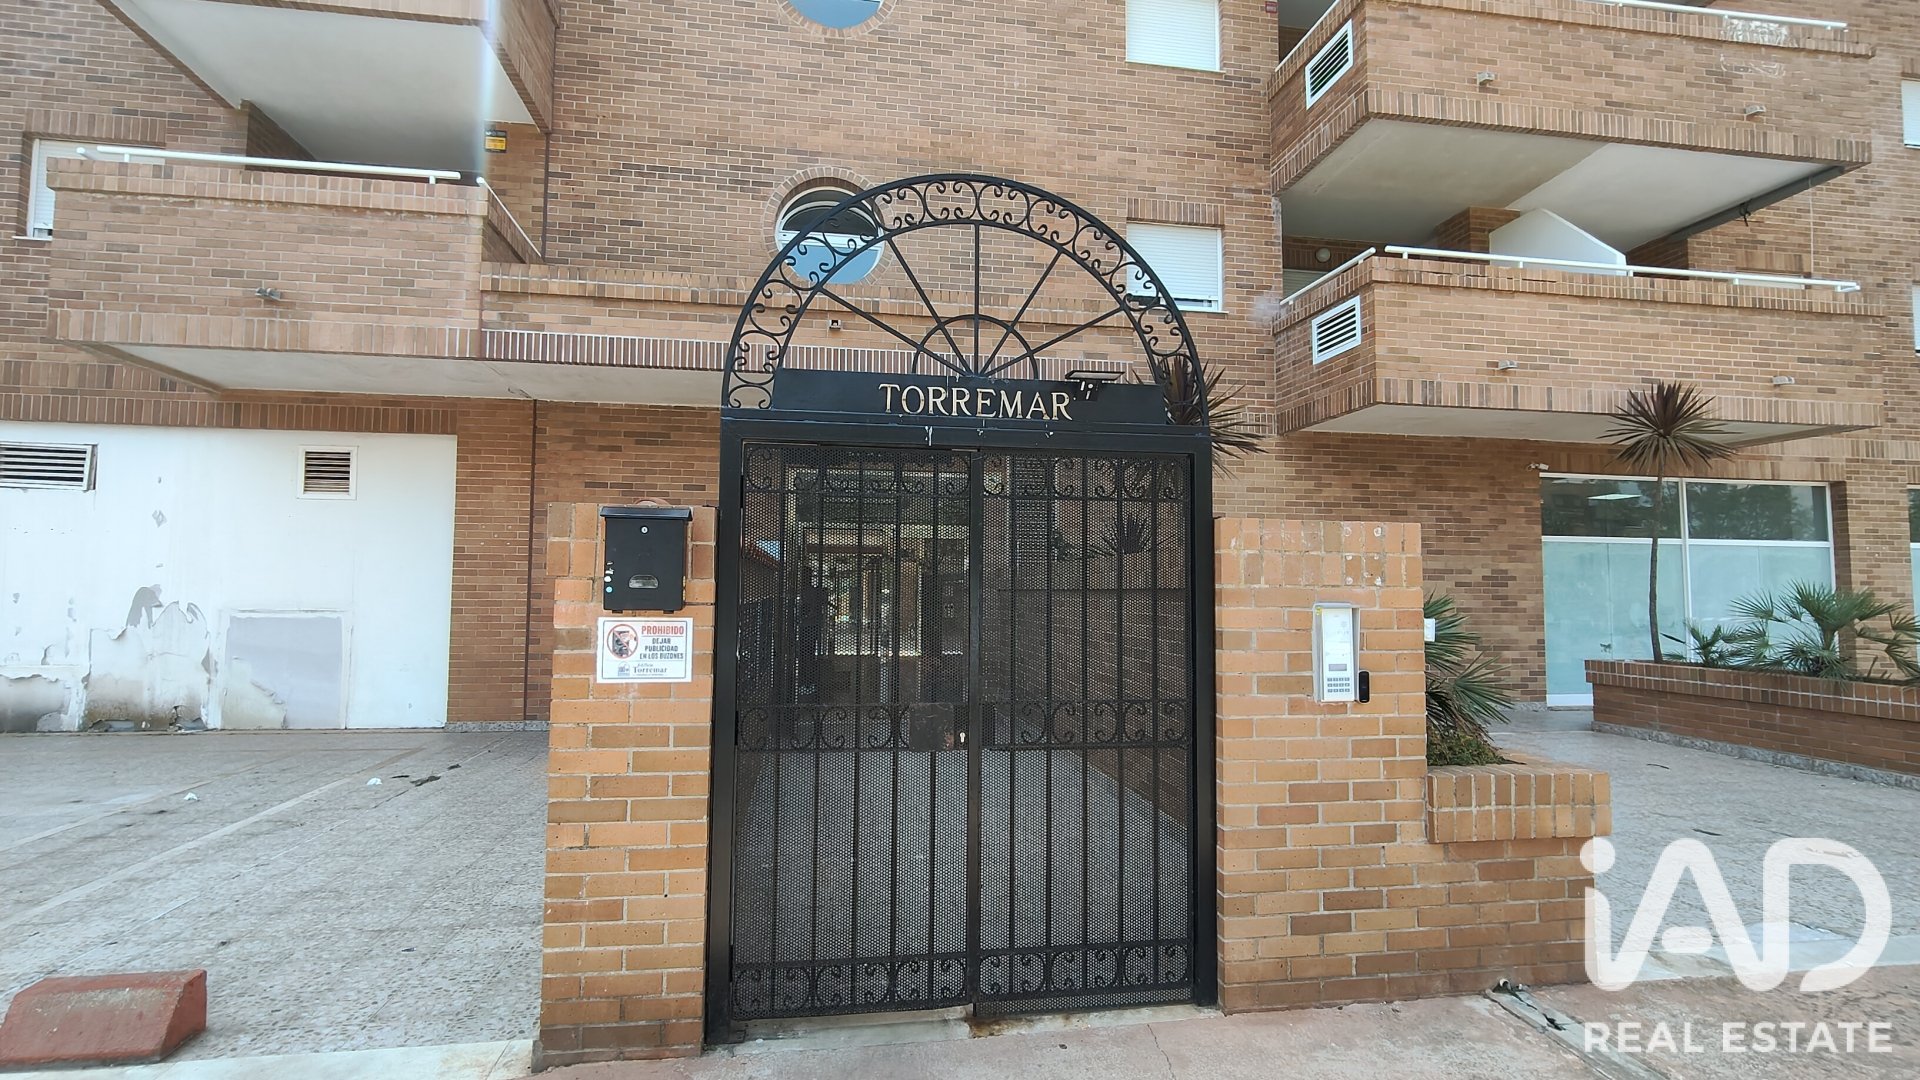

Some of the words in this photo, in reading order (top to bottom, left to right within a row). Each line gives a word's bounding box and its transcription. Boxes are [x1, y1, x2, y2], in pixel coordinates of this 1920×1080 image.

[879, 383, 1073, 421] TORREMAR
[641, 625, 684, 634] PROHIBIDO
[652, 637, 671, 645] DEJAR
